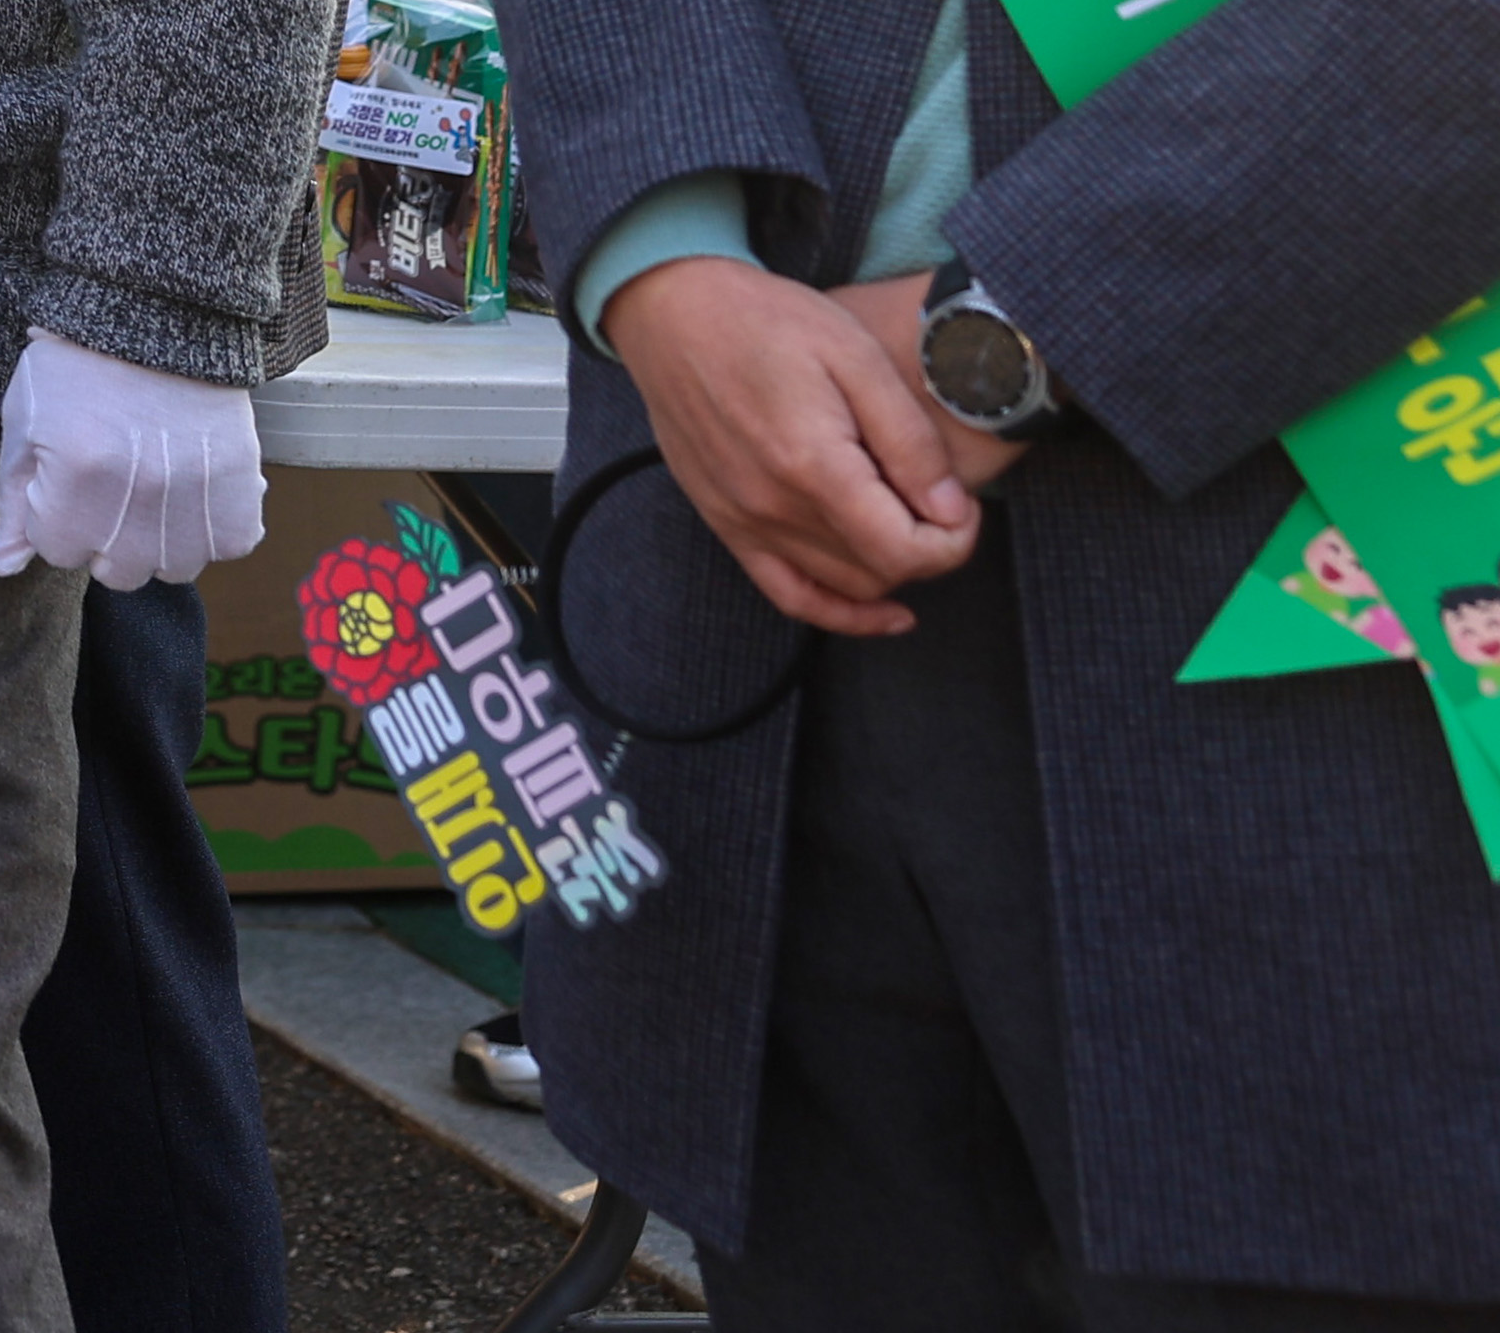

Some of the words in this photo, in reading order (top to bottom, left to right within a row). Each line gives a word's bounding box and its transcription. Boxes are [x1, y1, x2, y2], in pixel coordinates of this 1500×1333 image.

[386, 110, 419, 130] NO!
[414, 133, 448, 153] GO!
[368, 672, 546, 929] 인재를
[419, 569, 661, 923] 꽃피우다
